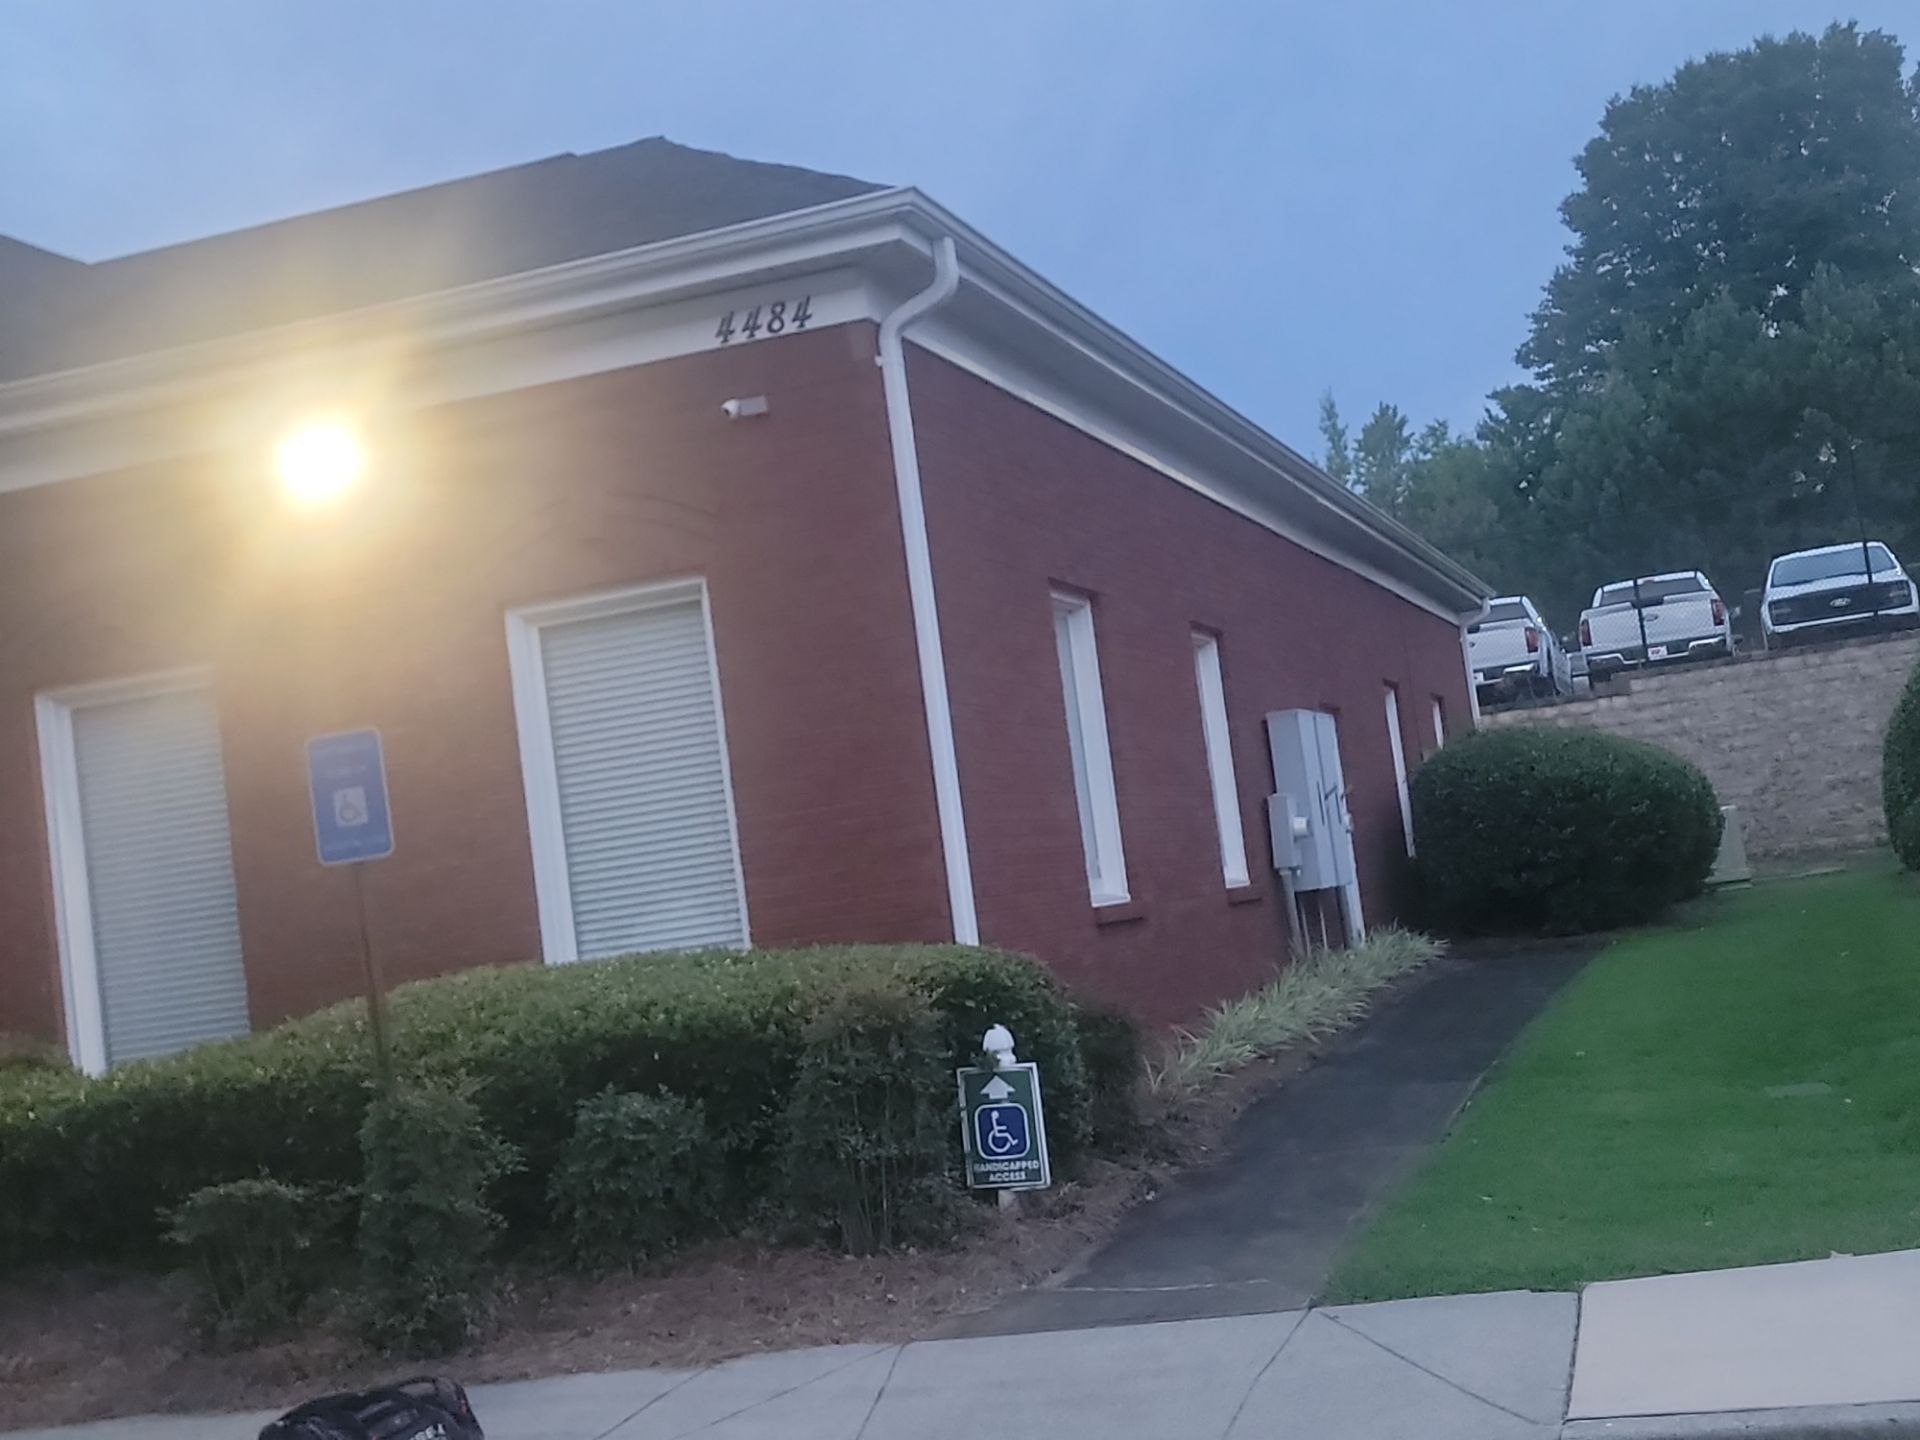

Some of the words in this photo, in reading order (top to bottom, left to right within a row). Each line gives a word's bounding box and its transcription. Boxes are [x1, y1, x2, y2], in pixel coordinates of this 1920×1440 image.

[714, 294, 813, 343] 4484
[974, 1160, 1040, 1171] HANDICAPPED
[989, 1171, 1026, 1181] ACCESS
